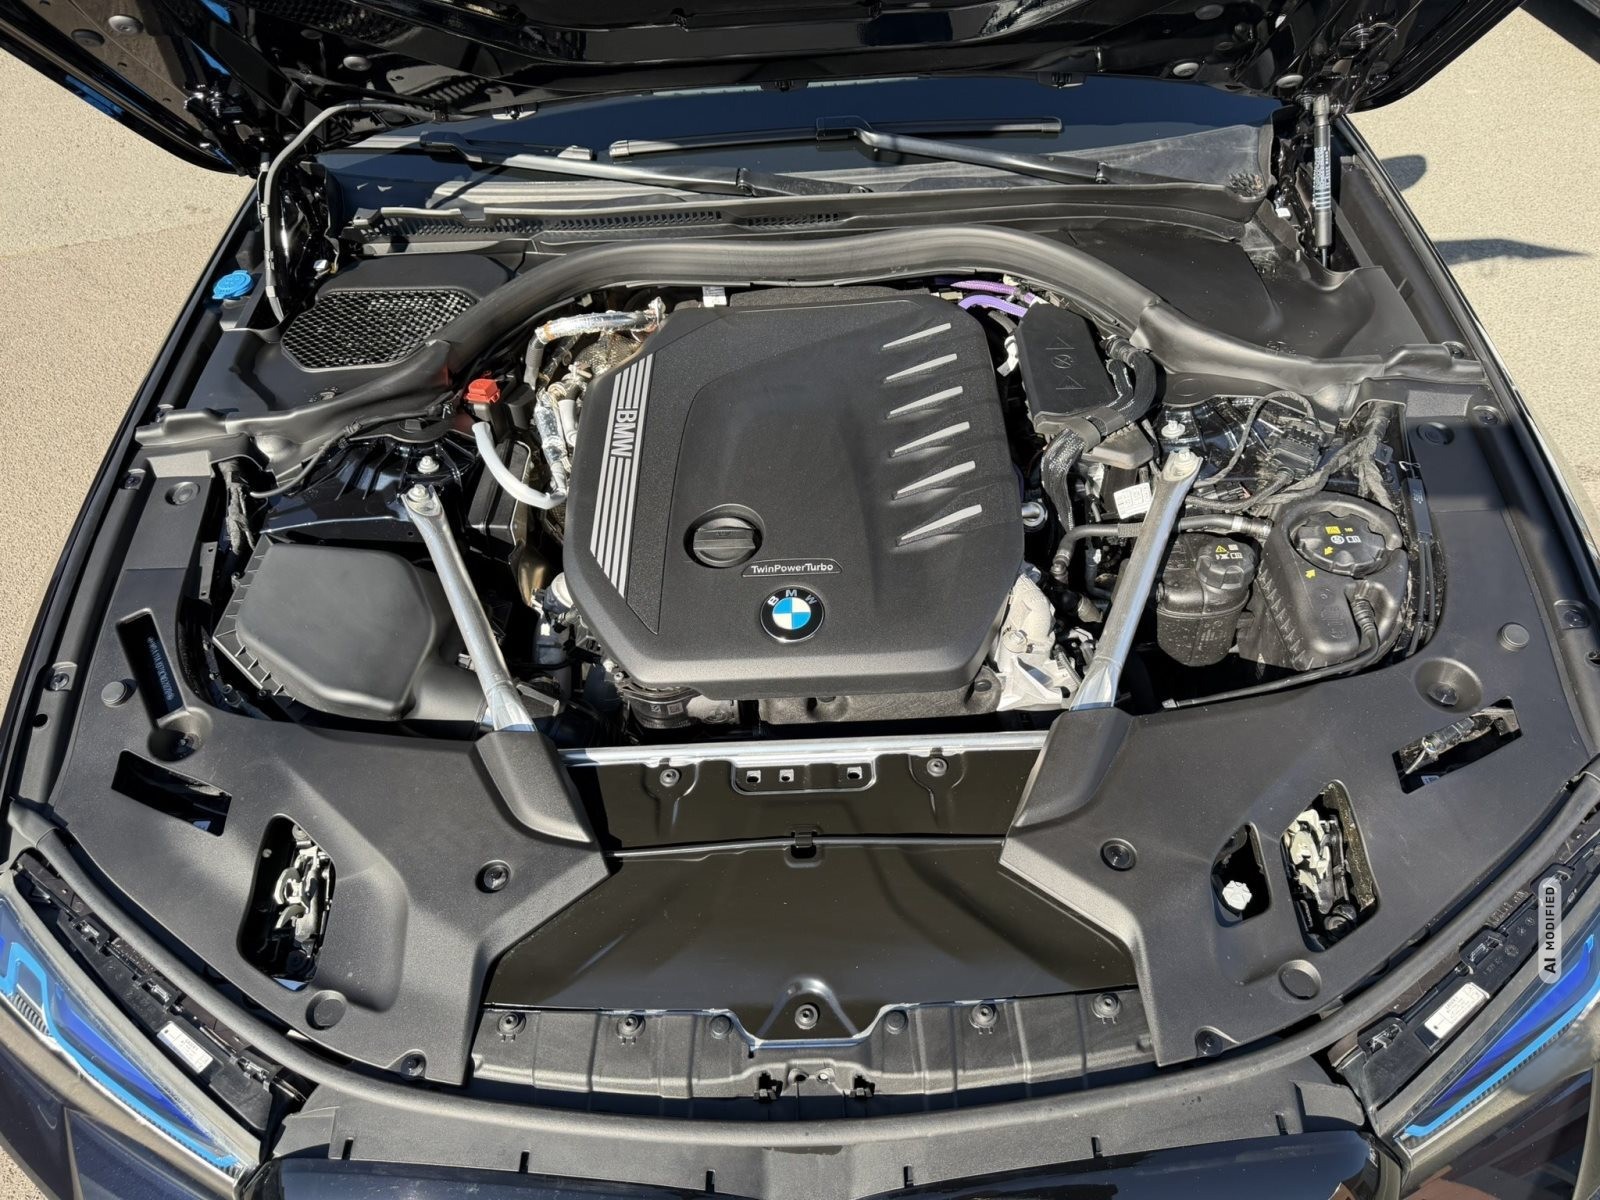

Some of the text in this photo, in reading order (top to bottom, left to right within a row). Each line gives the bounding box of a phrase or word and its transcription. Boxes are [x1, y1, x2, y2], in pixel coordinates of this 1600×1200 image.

[610, 410, 638, 457] BMW
[750, 562, 834, 574] TwinPowerTurbo
[767, 589, 818, 607] BMW
